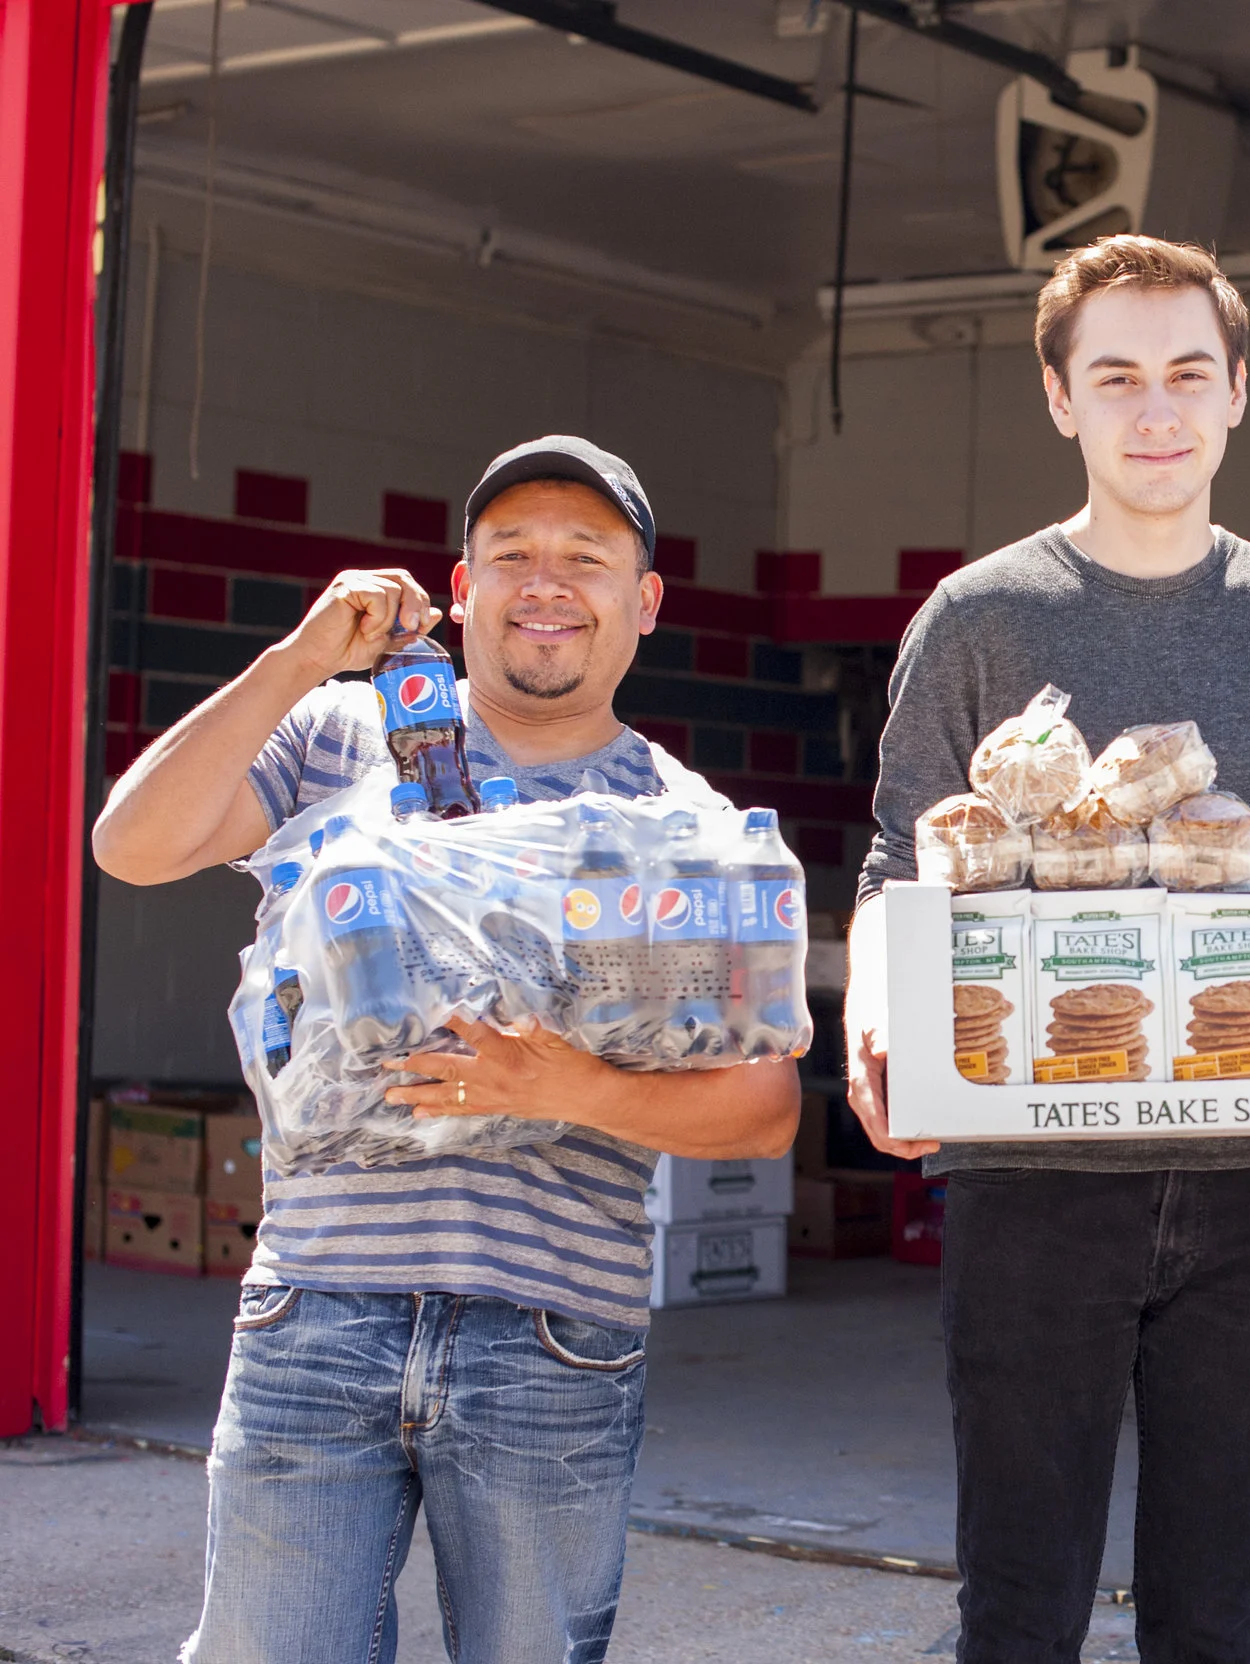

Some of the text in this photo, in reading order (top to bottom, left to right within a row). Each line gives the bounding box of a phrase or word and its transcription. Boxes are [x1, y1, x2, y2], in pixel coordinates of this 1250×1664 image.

[435, 674, 451, 708] pepsi
[360, 880, 381, 915] pepsi
[691, 889, 706, 926] pepsi
[960, 946, 988, 956] SHOP
[1060, 932, 1134, 949] TATE'S
[1100, 947, 1128, 955] SHOP
[1206, 943, 1234, 953] BAKE
[1027, 1102, 1120, 1128] TATE'S
[1136, 1098, 1220, 1125] BAKE
